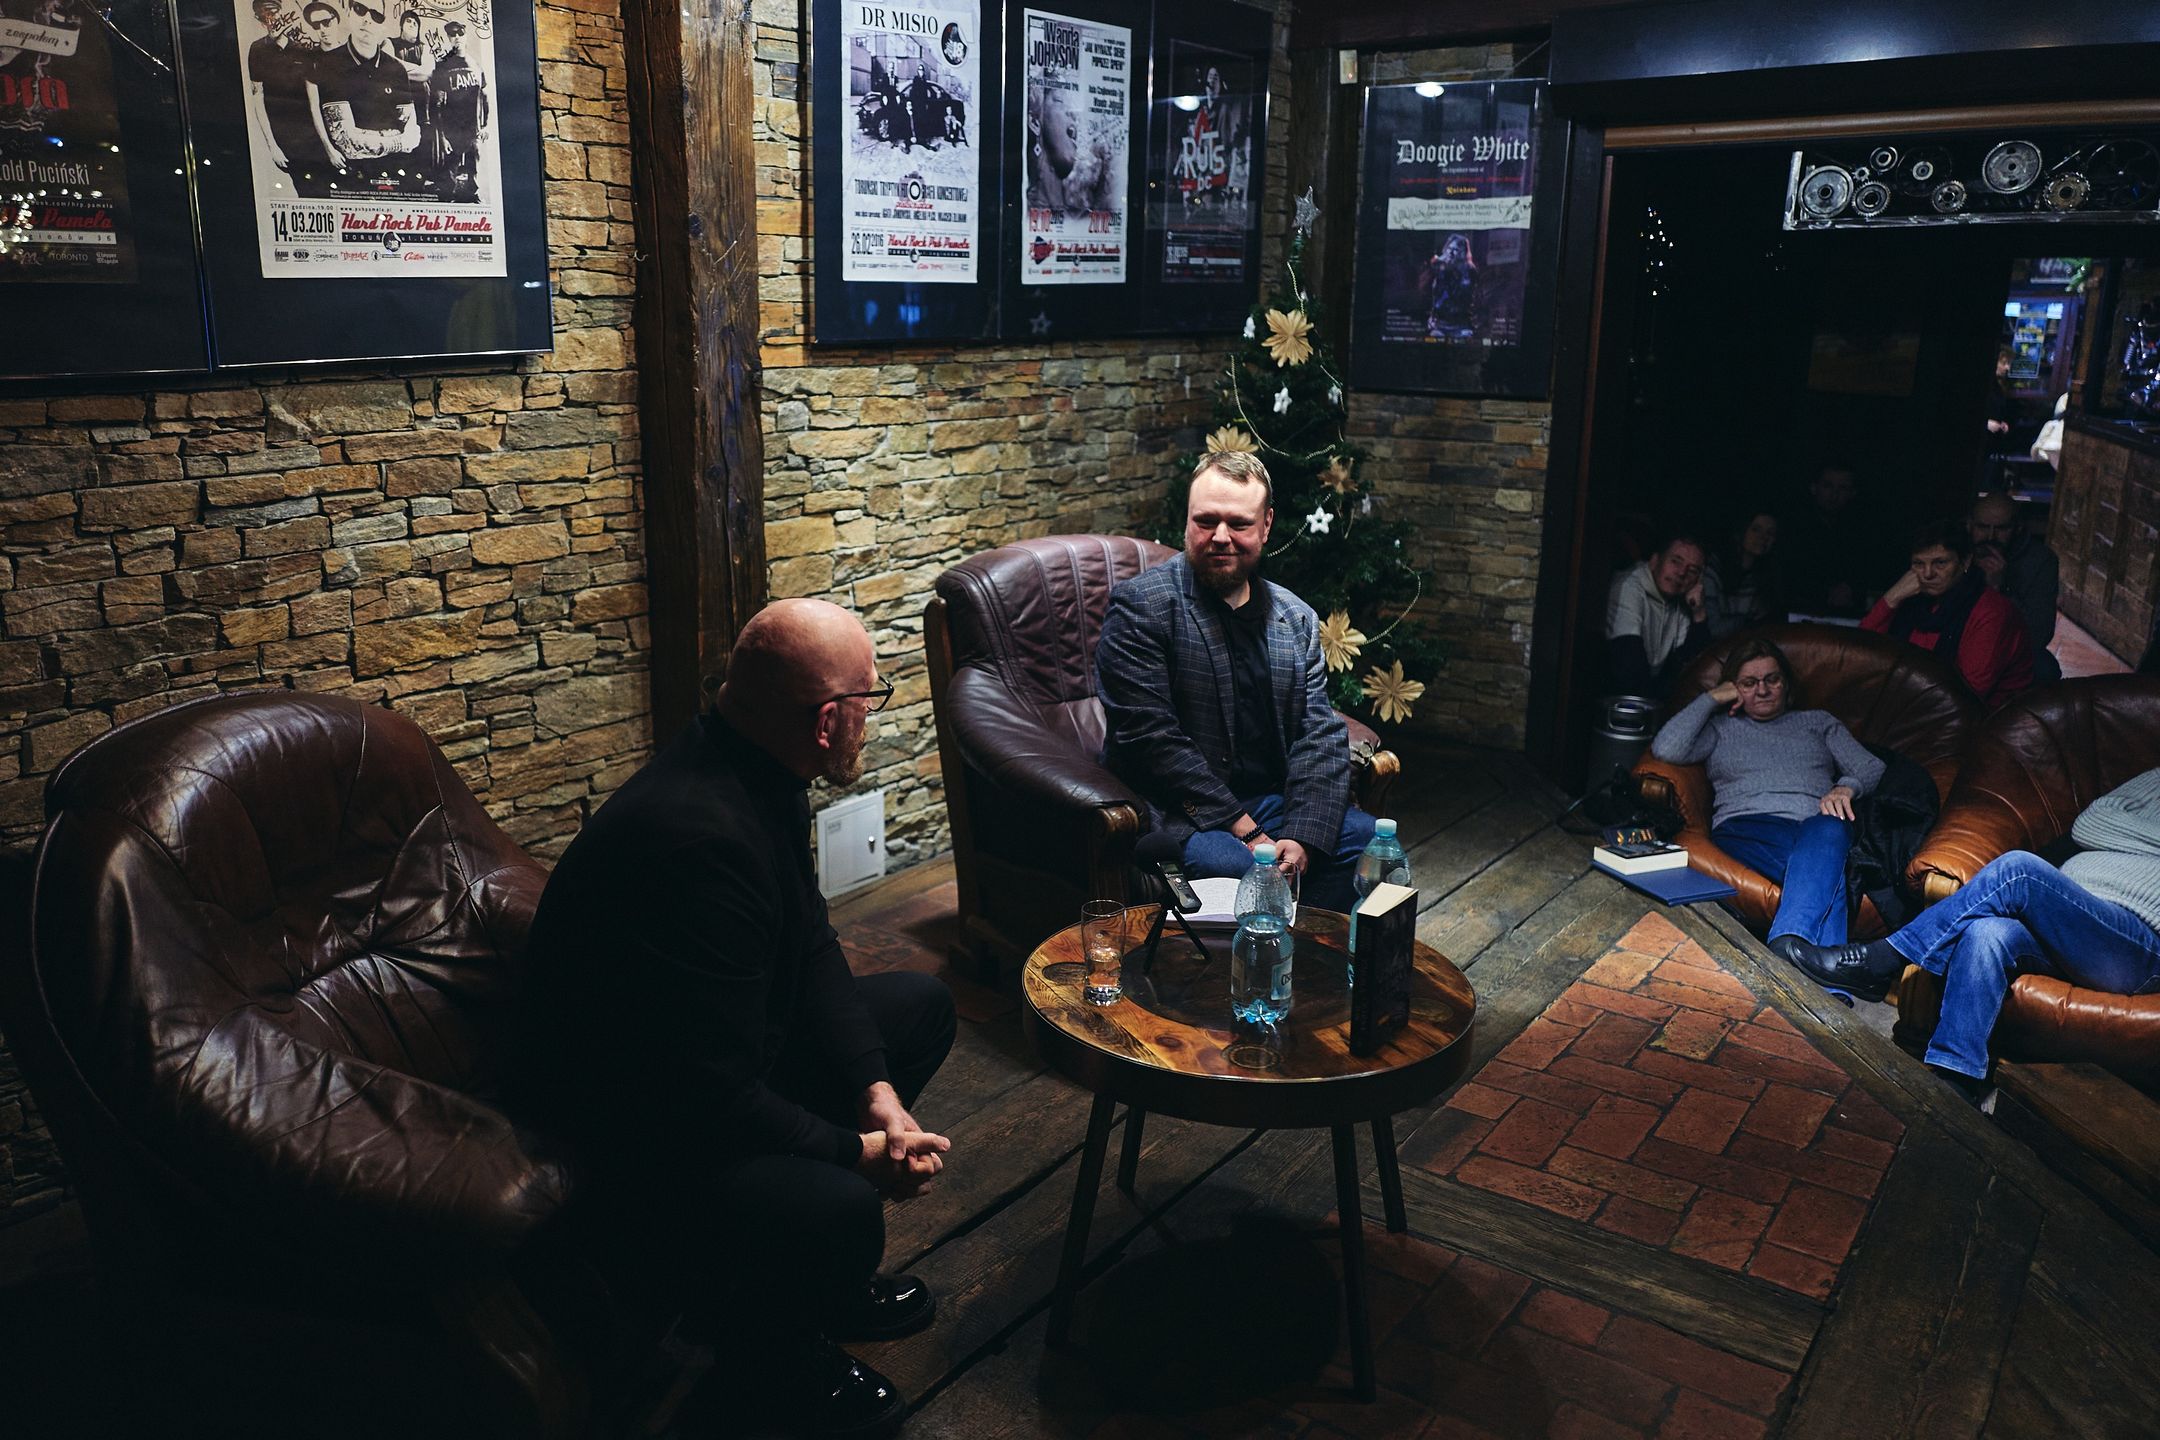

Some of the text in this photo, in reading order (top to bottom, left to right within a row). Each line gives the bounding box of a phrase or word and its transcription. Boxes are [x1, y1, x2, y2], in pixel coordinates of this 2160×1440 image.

[862, 6, 939, 35] DR MISIO
[1044, 20, 1080, 47] Wanda
[1030, 40, 1080, 70] JOHNSON
[1397, 136, 1530, 167] Doogie White
[28, 160, 91, 185] Puciński
[41, 208, 113, 228] Pamela
[271, 211, 335, 242] 14. 03.2016
[341, 212, 493, 232] Hard Rock Pub Pamela
[344, 233, 381, 242] TORUŃ
[51, 252, 89, 262] TORONTO
